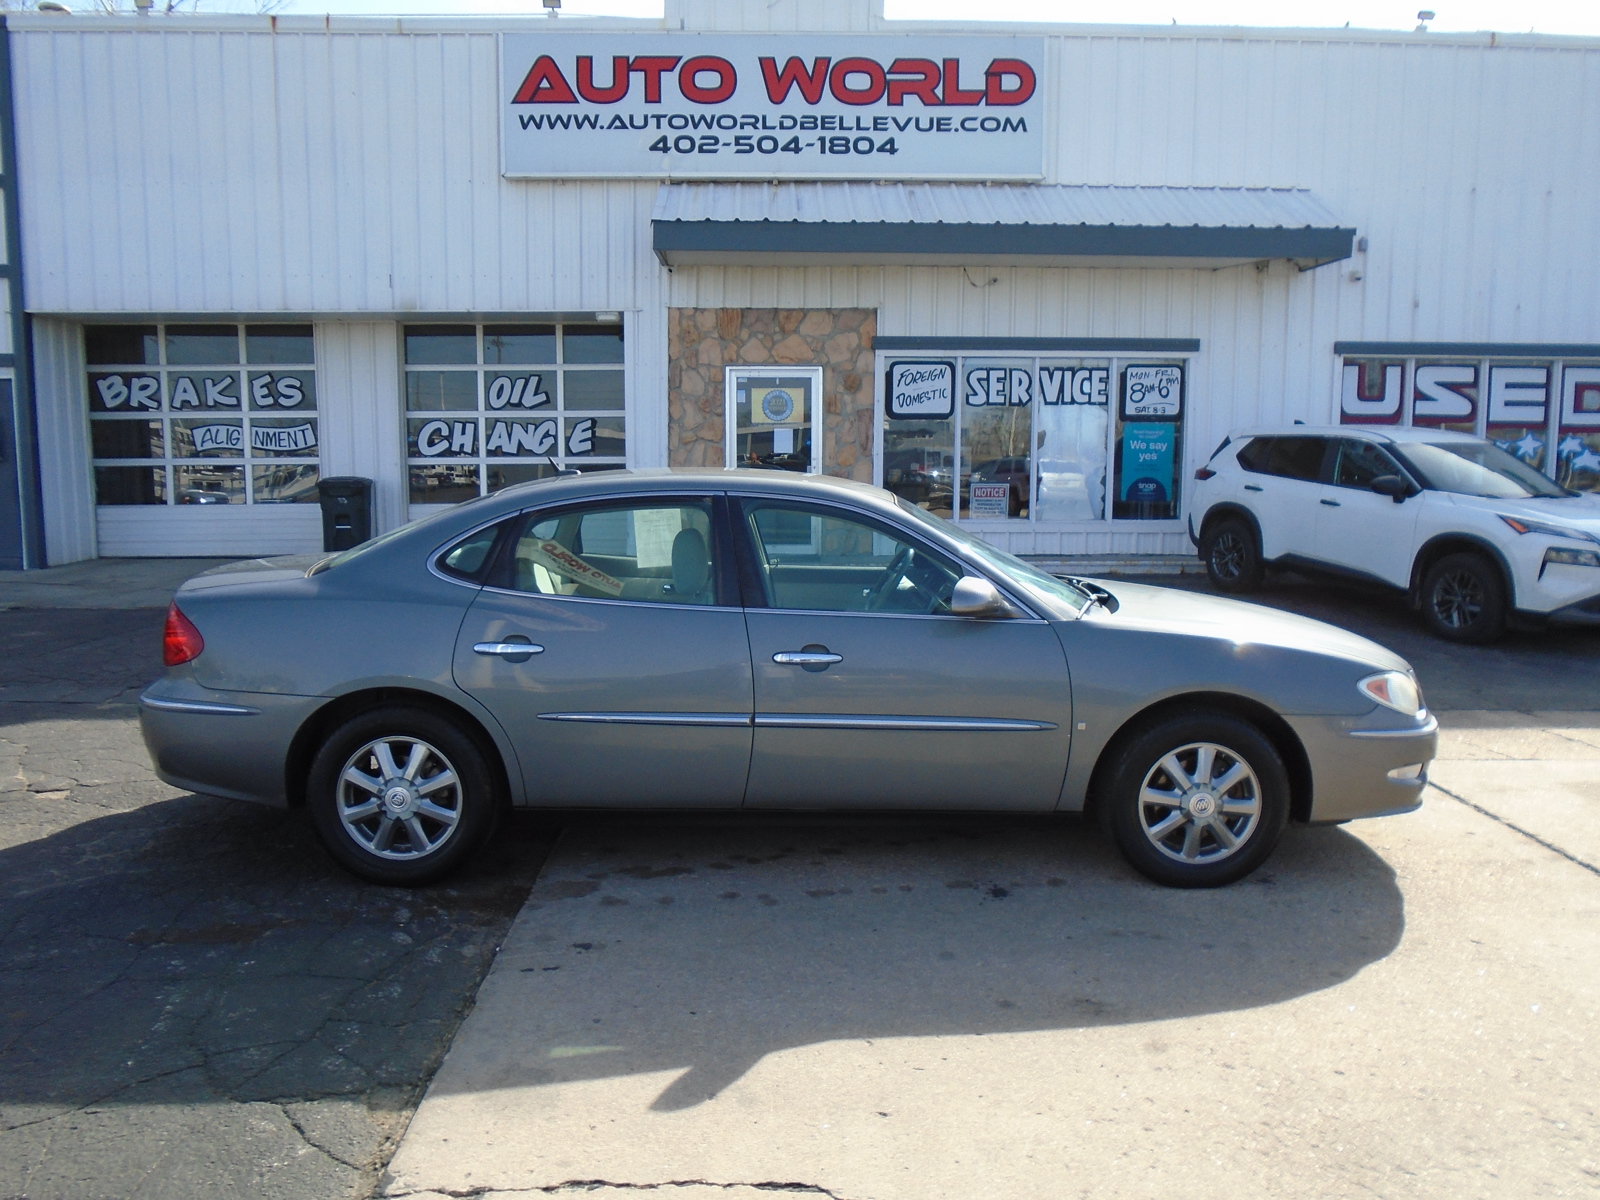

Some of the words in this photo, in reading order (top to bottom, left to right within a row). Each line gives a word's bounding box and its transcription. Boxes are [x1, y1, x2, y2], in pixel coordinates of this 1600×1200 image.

[510, 54, 738, 105] AUTO
[758, 56, 1037, 107] WORLD
[518, 113, 1029, 133] WWW.AUTOWORLDBELLEVUE.COM
[648, 135, 900, 156] 402-504-1804
[897, 367, 947, 387] FOREIGN
[965, 367, 1109, 407] SERVICE
[96, 372, 305, 410] BRAKES
[488, 374, 550, 409] OIL
[896, 388, 948, 408] DOMESTIC
[200, 427, 310, 448] ALIGNMENT
[417, 418, 597, 456] CHANGE
[1130, 440, 1146, 449] We
[1149, 441, 1167, 452] say
[1139, 453, 1158, 462] yes
[975, 488, 1005, 497] NOTICE
